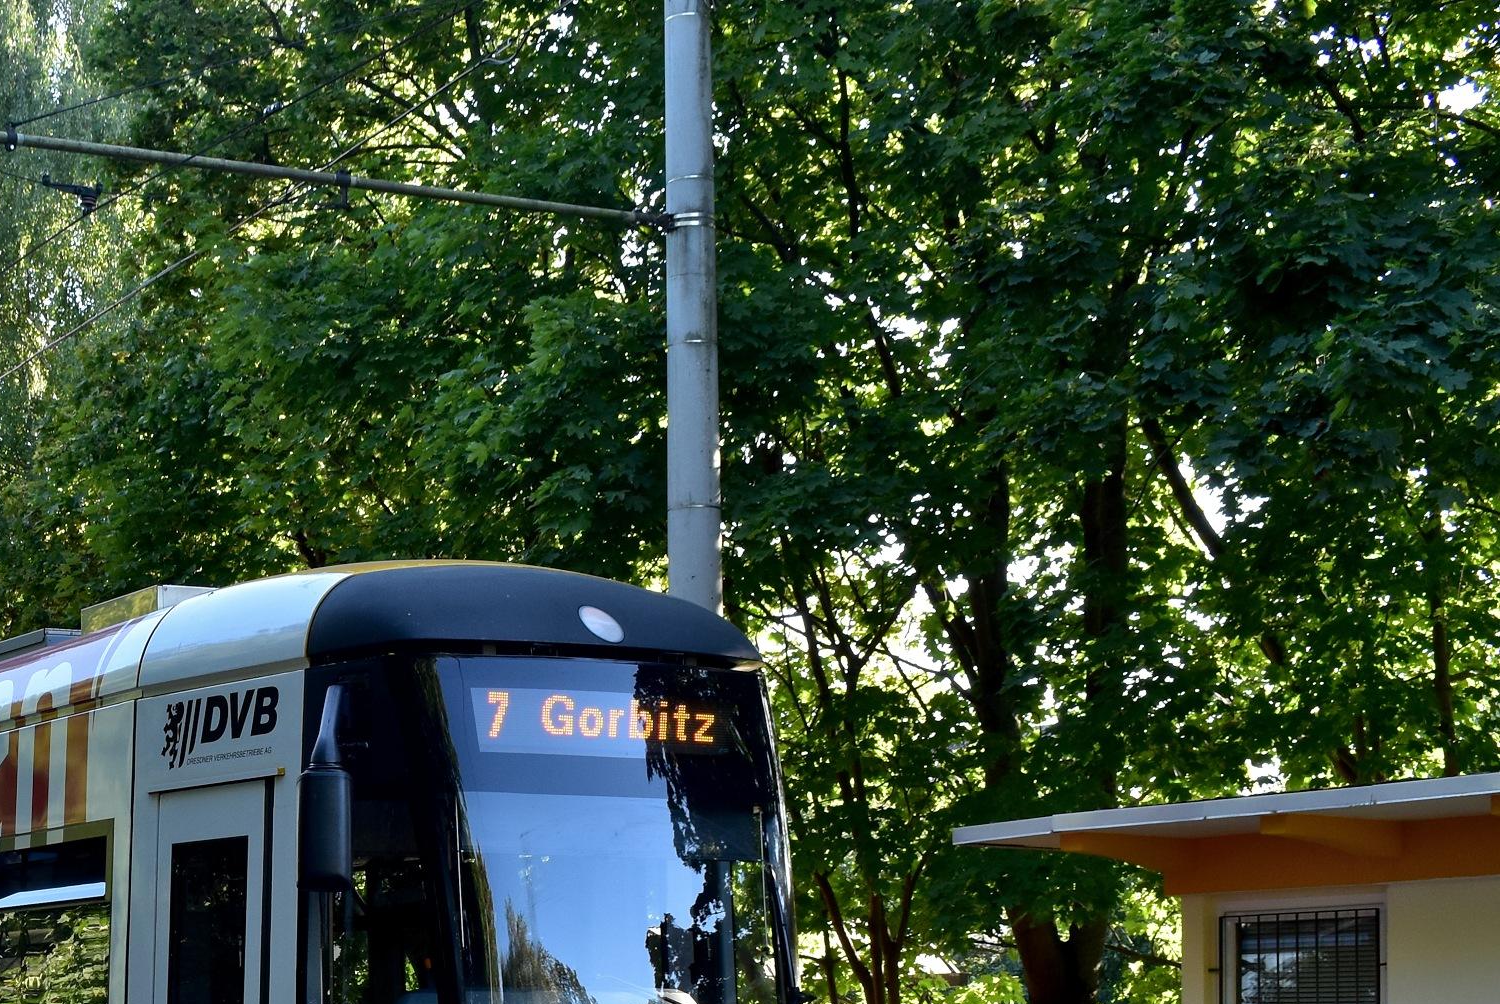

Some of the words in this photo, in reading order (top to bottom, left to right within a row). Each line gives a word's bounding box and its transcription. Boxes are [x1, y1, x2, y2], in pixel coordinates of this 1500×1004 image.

[200, 686, 279, 744] DVB
[488, 691, 509, 738] 7
[541, 694, 716, 743] Gorbitz
[186, 754, 213, 765] DRESDNER
[213, 747, 264, 762] VERKEHRSBETRIEBE
[263, 746, 272, 756] AG
